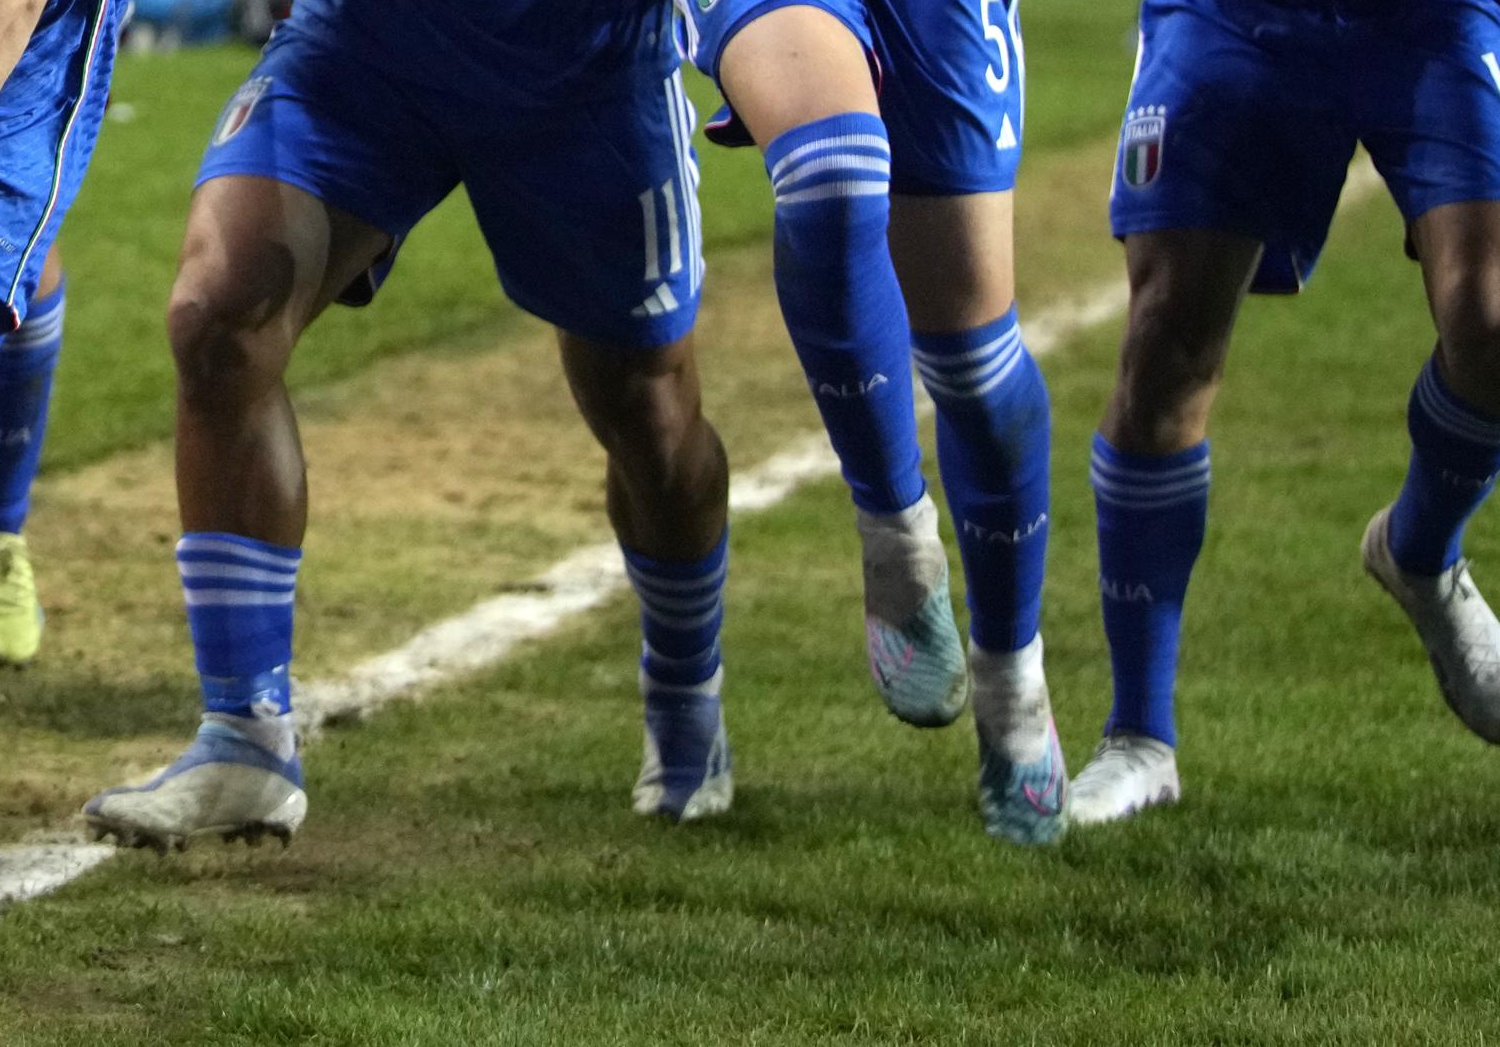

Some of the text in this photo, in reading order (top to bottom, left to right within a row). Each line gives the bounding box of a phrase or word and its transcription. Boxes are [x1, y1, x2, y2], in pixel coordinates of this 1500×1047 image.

[638, 178, 682, 281] 11
[820, 372, 889, 396] ALIA
[1102, 578, 1154, 603] ALIA
